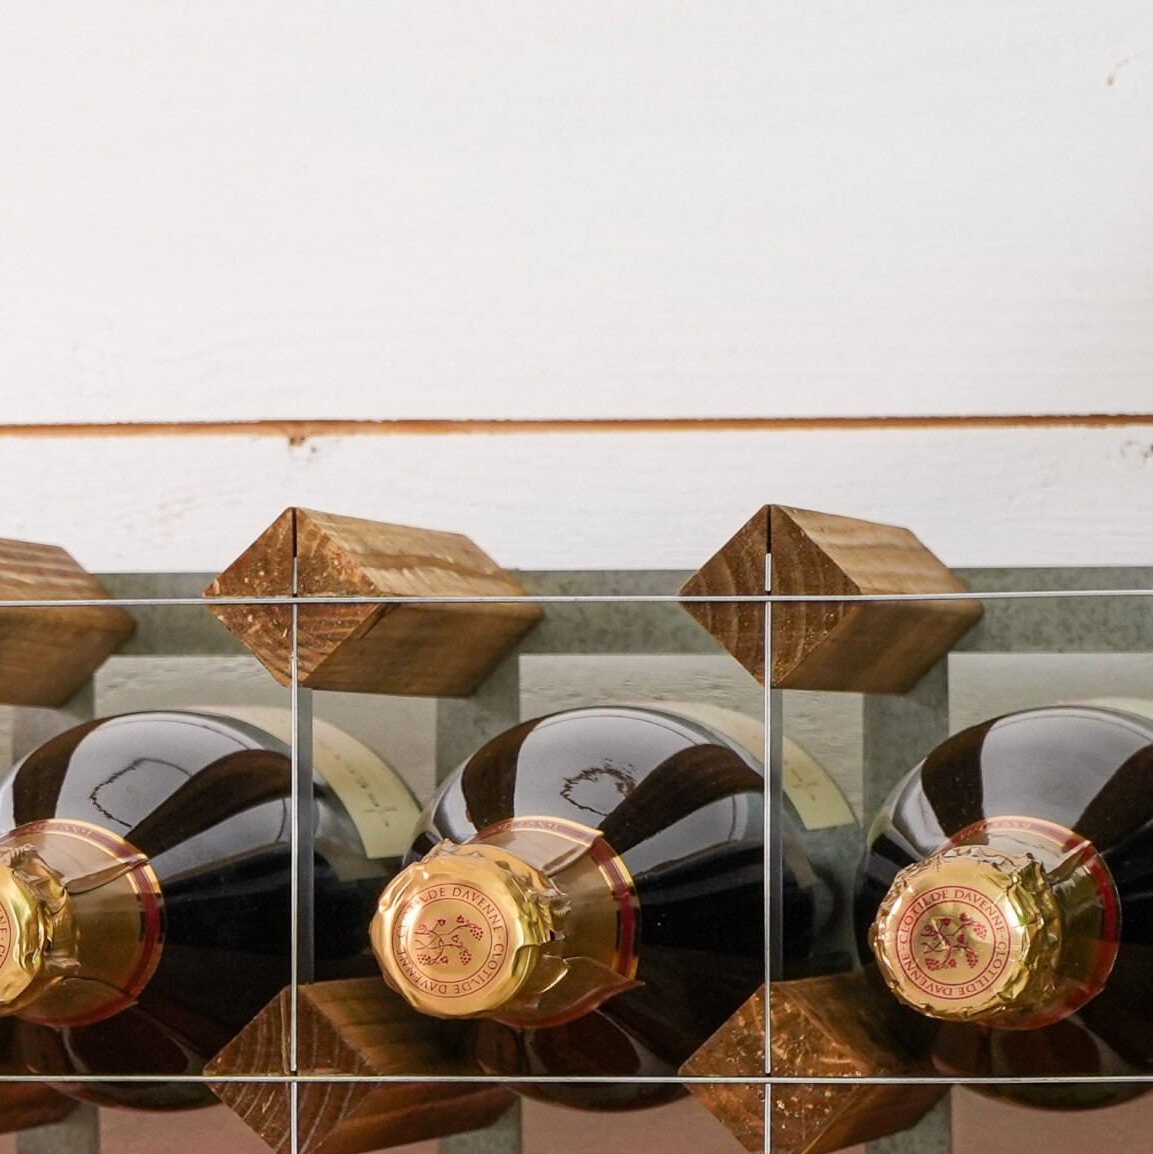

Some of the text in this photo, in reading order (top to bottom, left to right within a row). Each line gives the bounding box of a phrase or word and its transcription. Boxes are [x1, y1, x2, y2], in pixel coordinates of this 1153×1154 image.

[452, 887, 504, 933] DAVENNE
[899, 889, 1006, 945] CLOTILDE DAVENNE
[397, 943, 504, 994] CLOTILDE DAVENNE
[903, 941, 1006, 997] CLOTILDE DAVENNE
